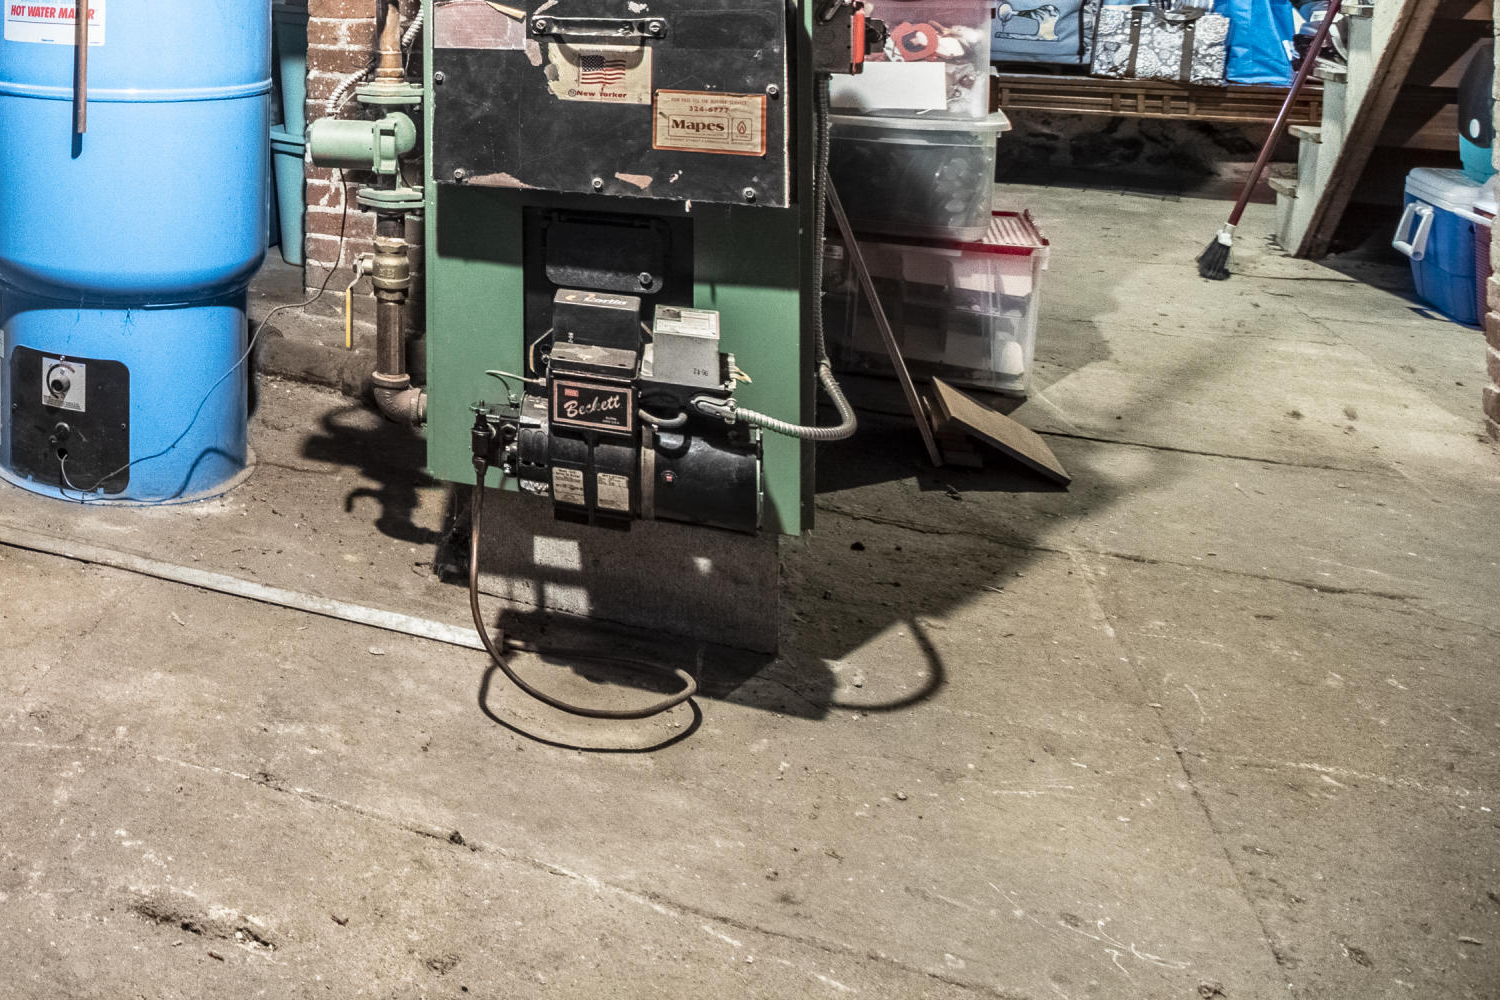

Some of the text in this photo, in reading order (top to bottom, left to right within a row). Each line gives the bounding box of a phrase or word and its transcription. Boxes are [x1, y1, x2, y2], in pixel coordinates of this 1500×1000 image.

[11, 4, 26, 17] HOT
[27, 5, 57, 19] WATER
[576, 89, 596, 97] New
[671, 119, 725, 132] Mapes
[564, 395, 621, 418] Beckett
